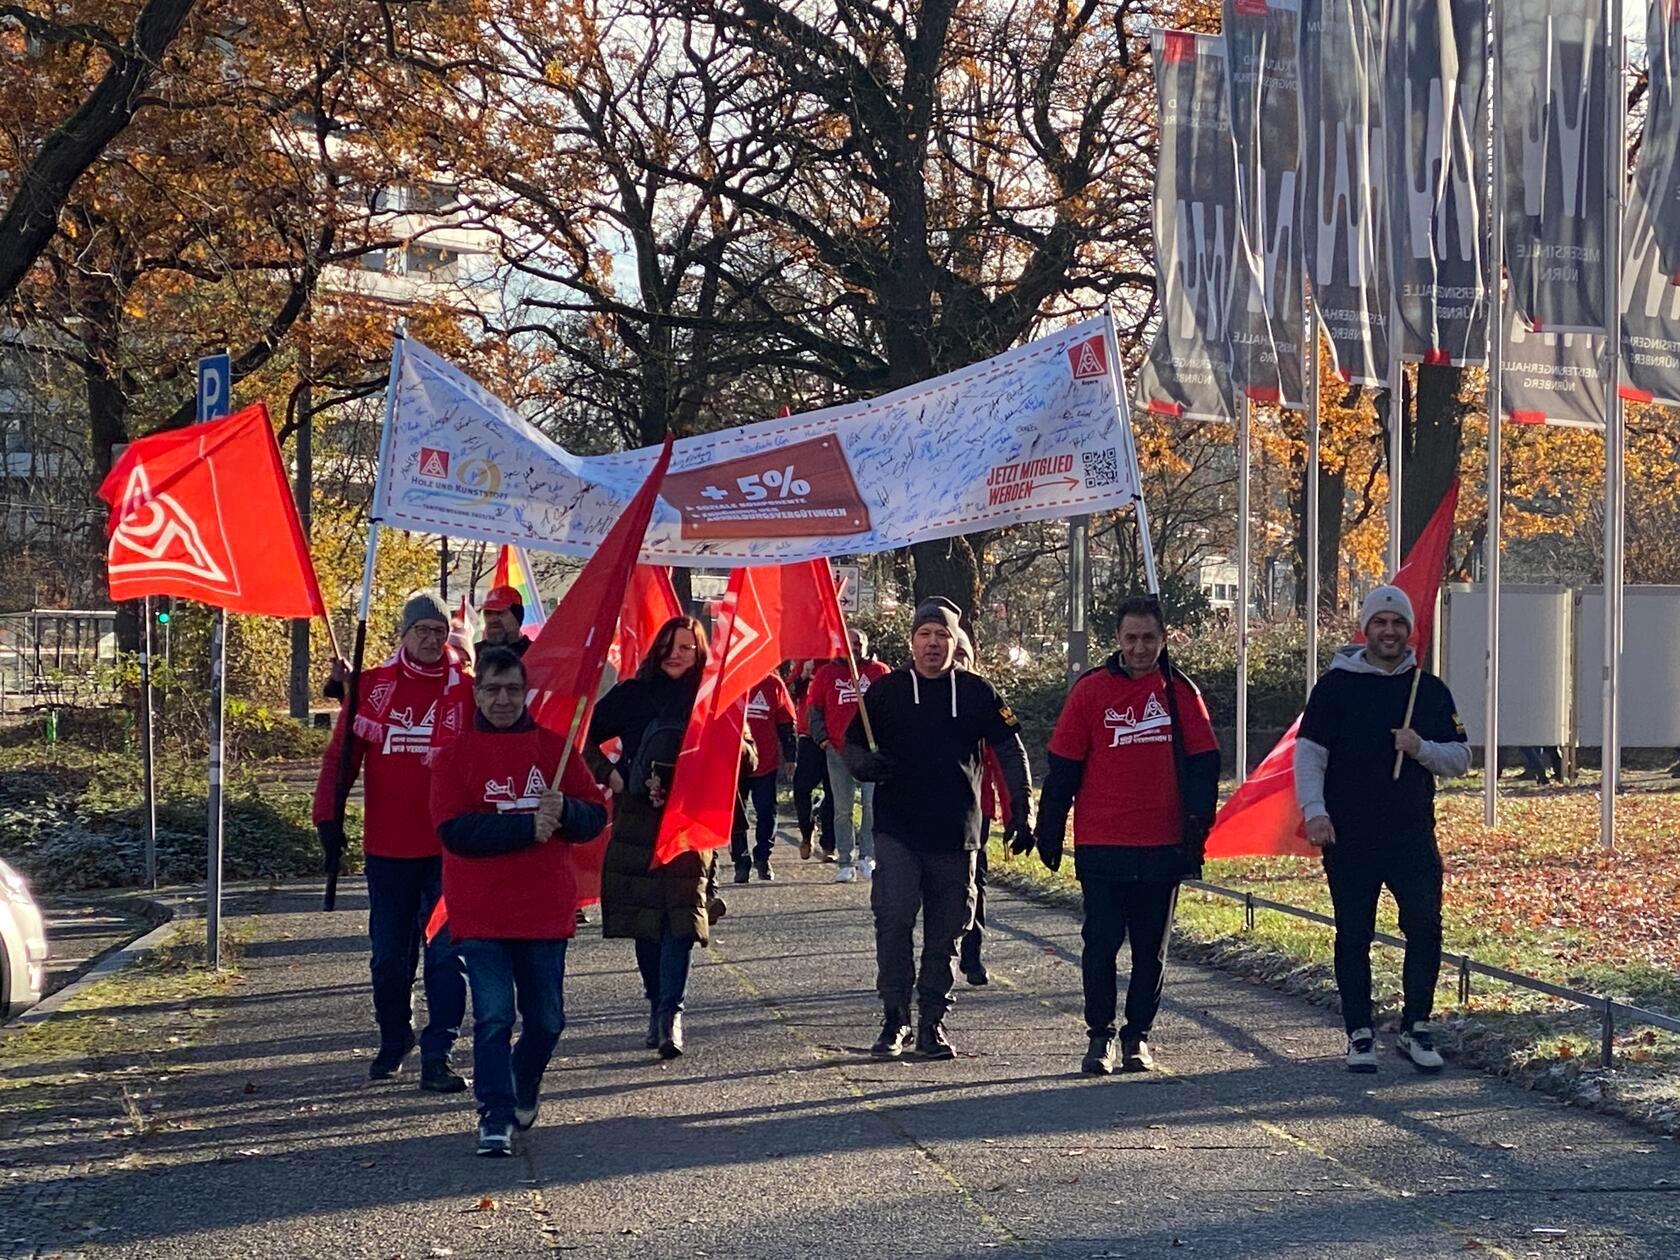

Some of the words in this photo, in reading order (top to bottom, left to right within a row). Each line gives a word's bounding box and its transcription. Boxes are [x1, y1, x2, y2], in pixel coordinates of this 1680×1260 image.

[736, 464, 811, 501] 5%
[987, 463, 1020, 486] JETZT
[1019, 454, 1073, 480] MITGLIED
[435, 481, 454, 491] UND
[989, 480, 1033, 506] WERDEN
[696, 503, 737, 511] SOZIALE
[738, 498, 807, 508] KOMPONENTE
